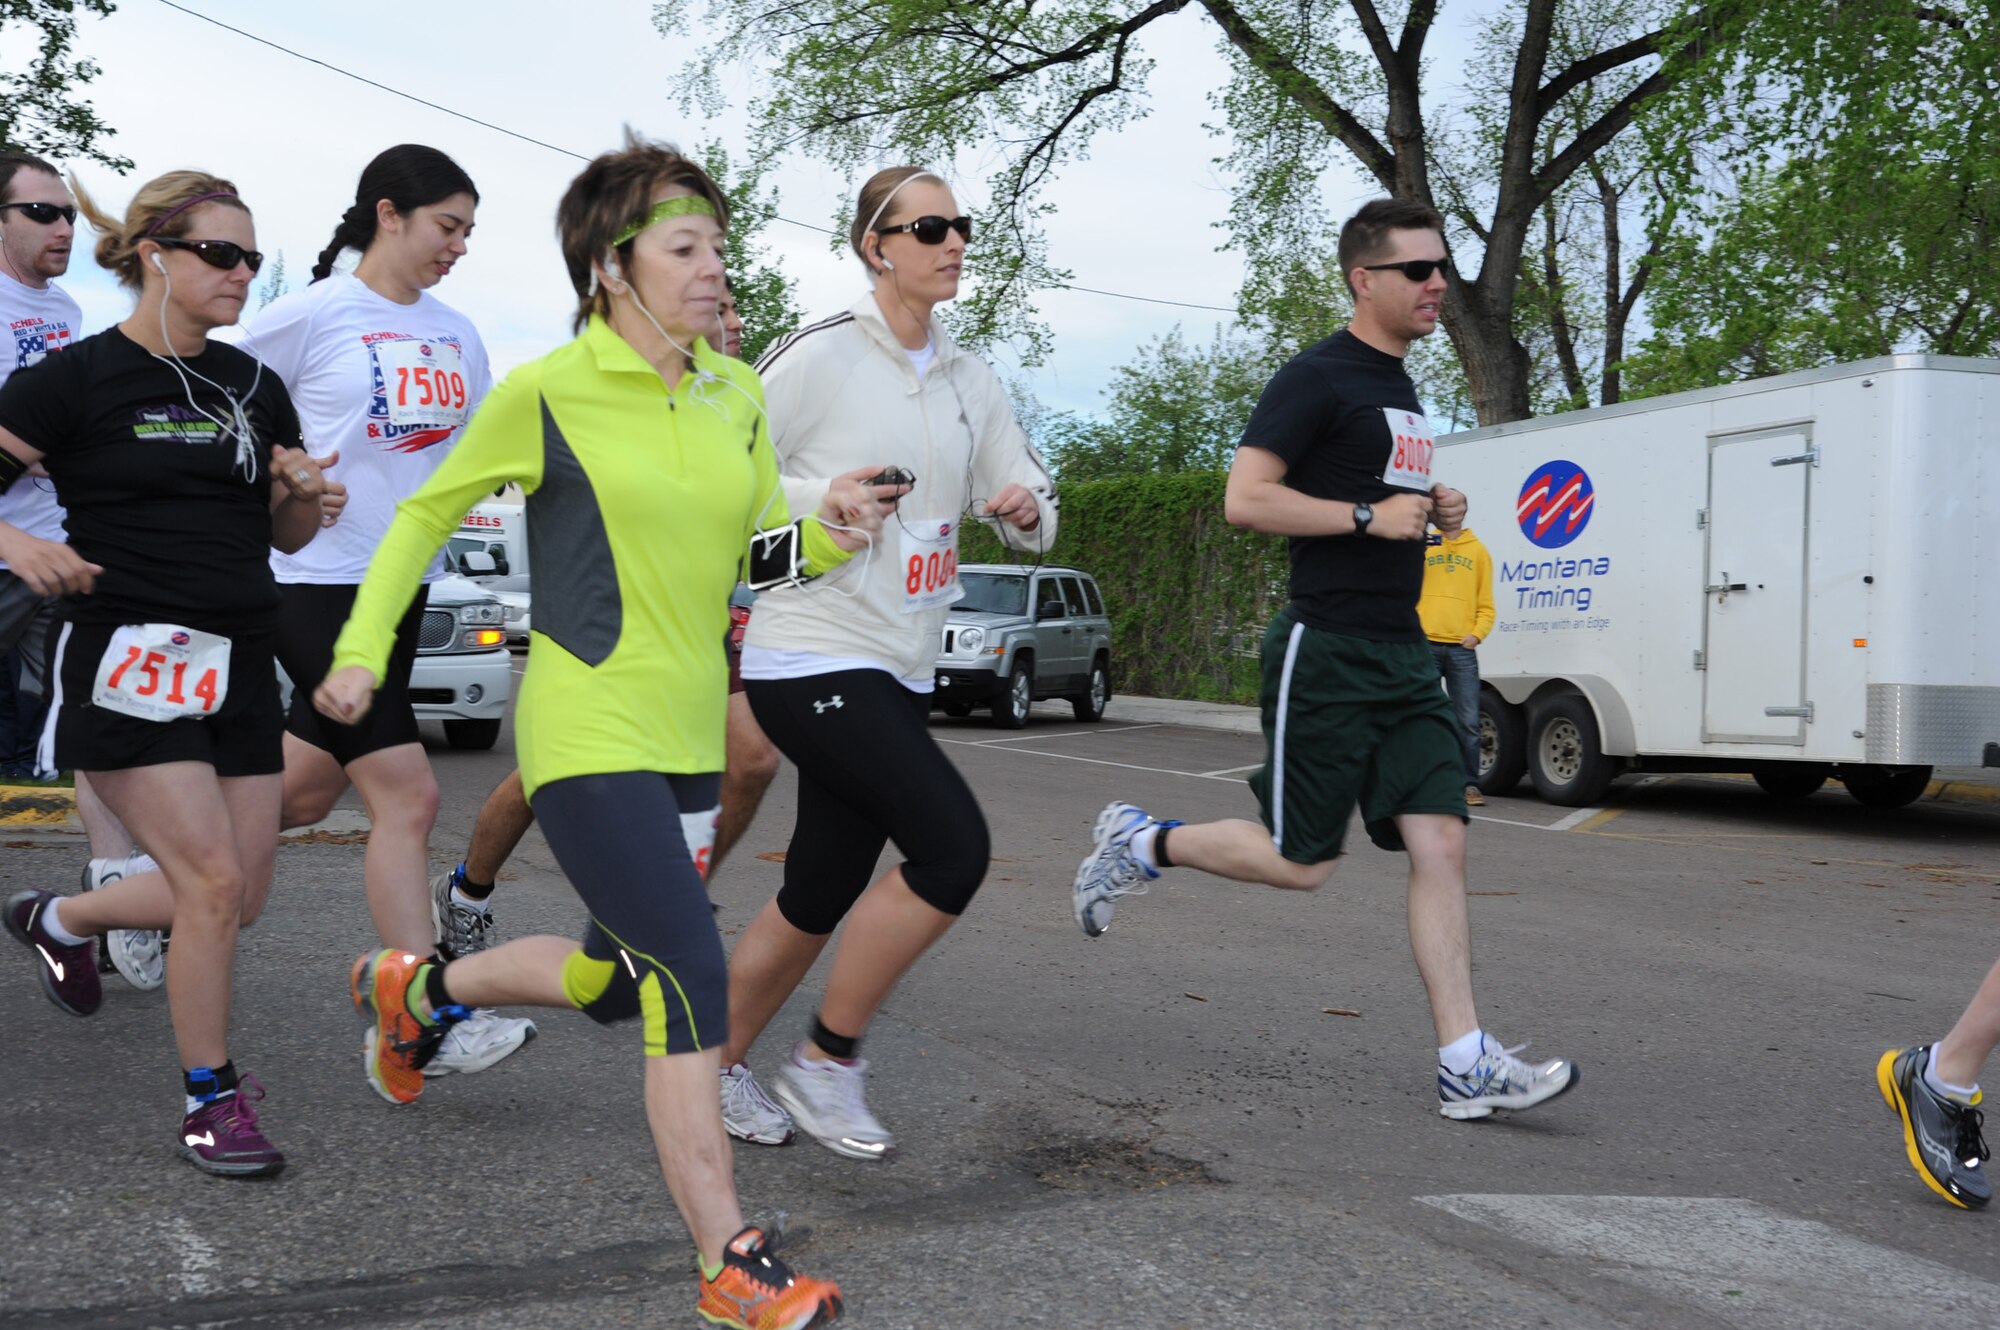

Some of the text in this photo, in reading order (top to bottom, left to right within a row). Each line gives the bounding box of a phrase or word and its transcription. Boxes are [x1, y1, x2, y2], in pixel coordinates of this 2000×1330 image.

[396, 366, 466, 409] 7509
[1500, 556, 1610, 583] Montana
[1516, 585, 1592, 612] Timing
[107, 645, 217, 712] 7514
